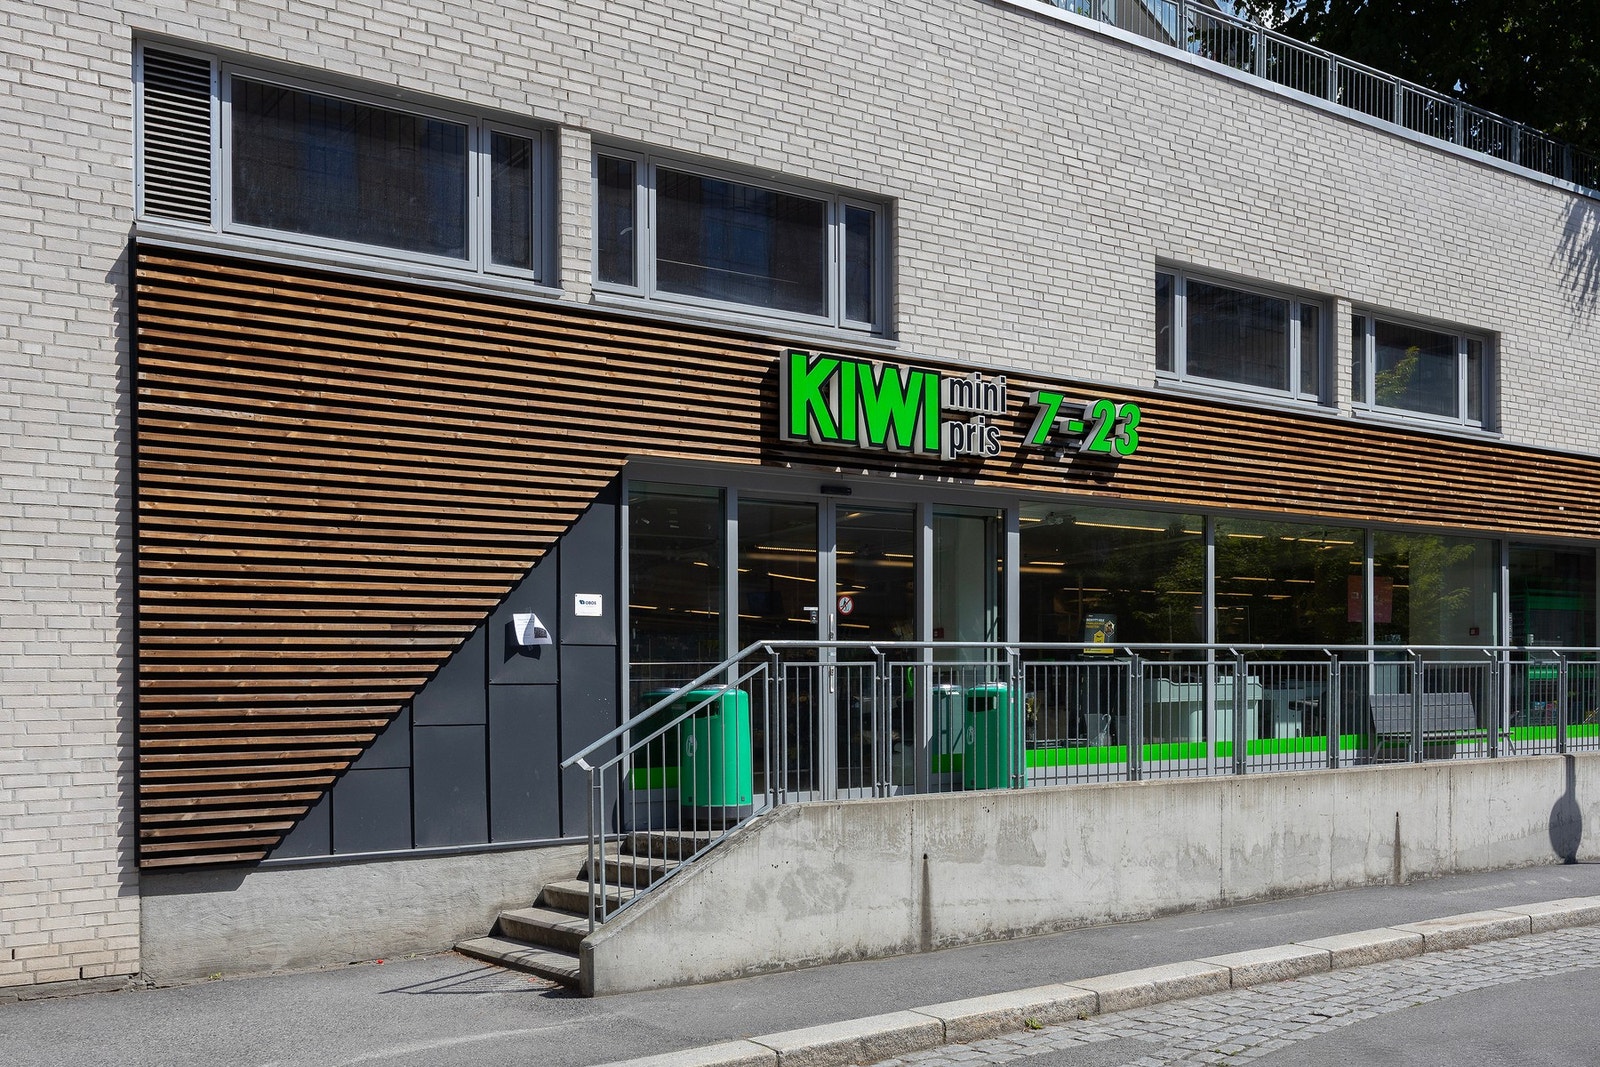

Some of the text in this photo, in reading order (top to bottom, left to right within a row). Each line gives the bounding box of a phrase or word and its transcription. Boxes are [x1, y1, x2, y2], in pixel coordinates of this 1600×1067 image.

[786, 349, 942, 455] KIWI
[949, 372, 1007, 414] mini
[949, 416, 1001, 460] pris
